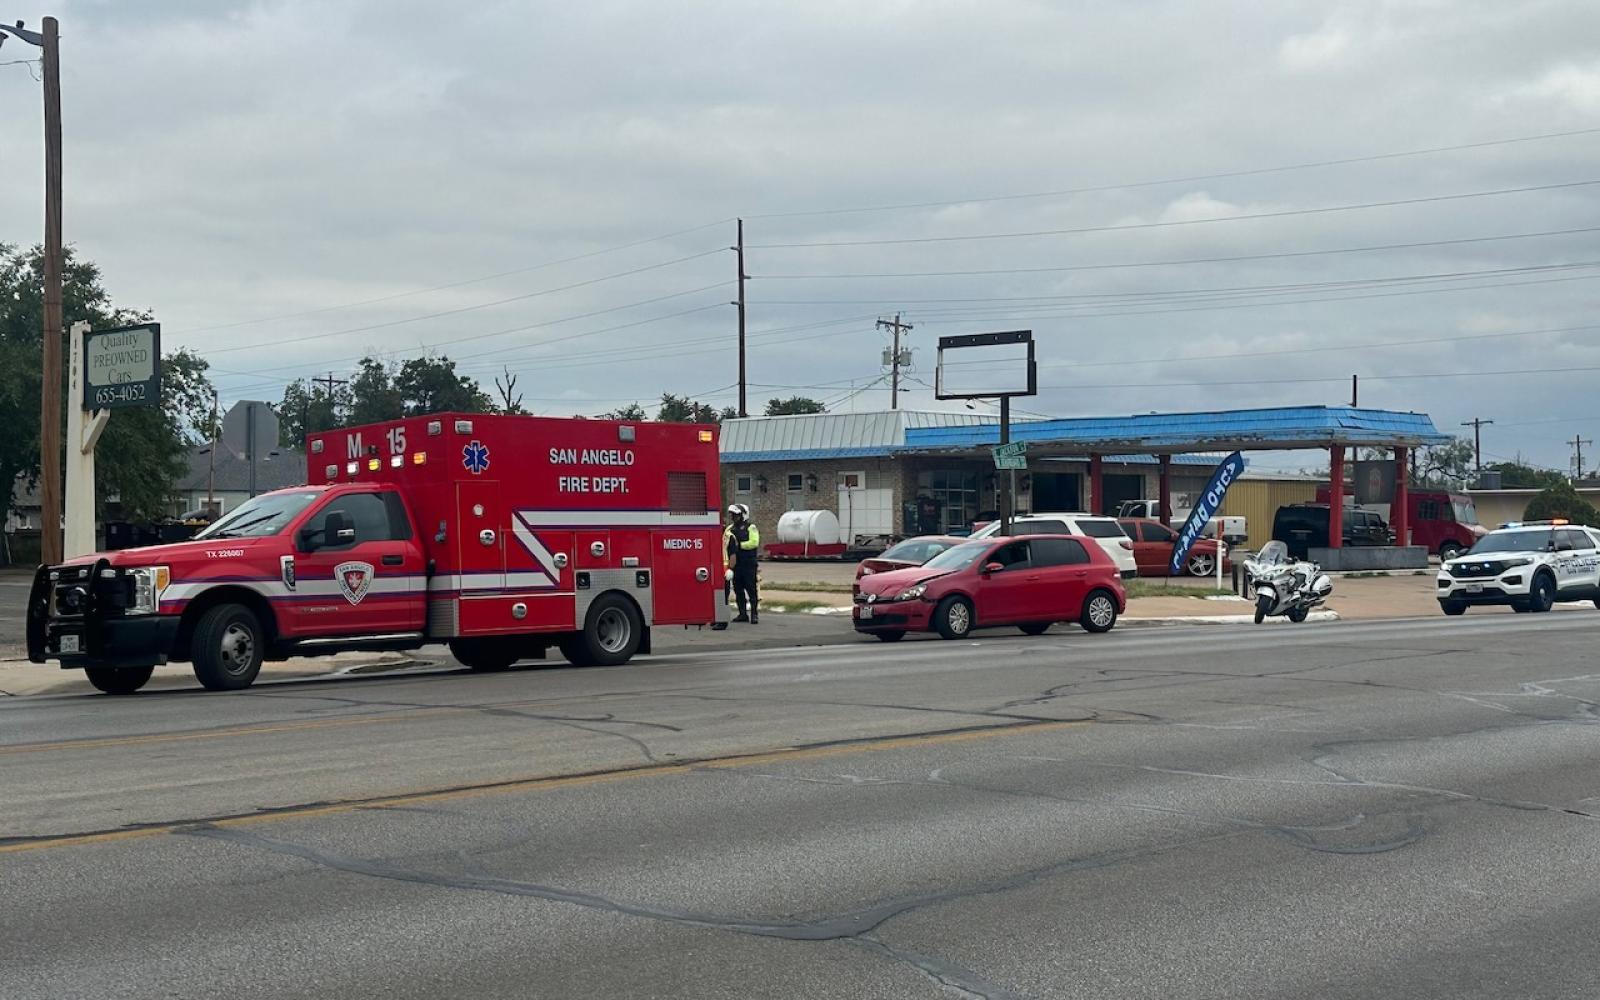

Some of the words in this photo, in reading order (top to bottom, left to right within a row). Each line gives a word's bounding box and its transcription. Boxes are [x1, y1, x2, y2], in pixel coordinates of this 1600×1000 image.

[101, 331, 138, 350] Quality
[94, 349, 147, 368] PREOWNED
[108, 368, 132, 384] Cars
[95, 384, 145, 403] 655-4052
[347, 432, 362, 459] M
[386, 427, 406, 454] 15
[549, 448, 577, 464] SAN
[581, 449, 635, 465] ANGELO
[559, 476, 589, 492] FIRE
[592, 477, 630, 493] DEPT.
[663, 538, 692, 549] MEDIC
[693, 538, 703, 549] 15
[205, 550, 217, 559] TX
